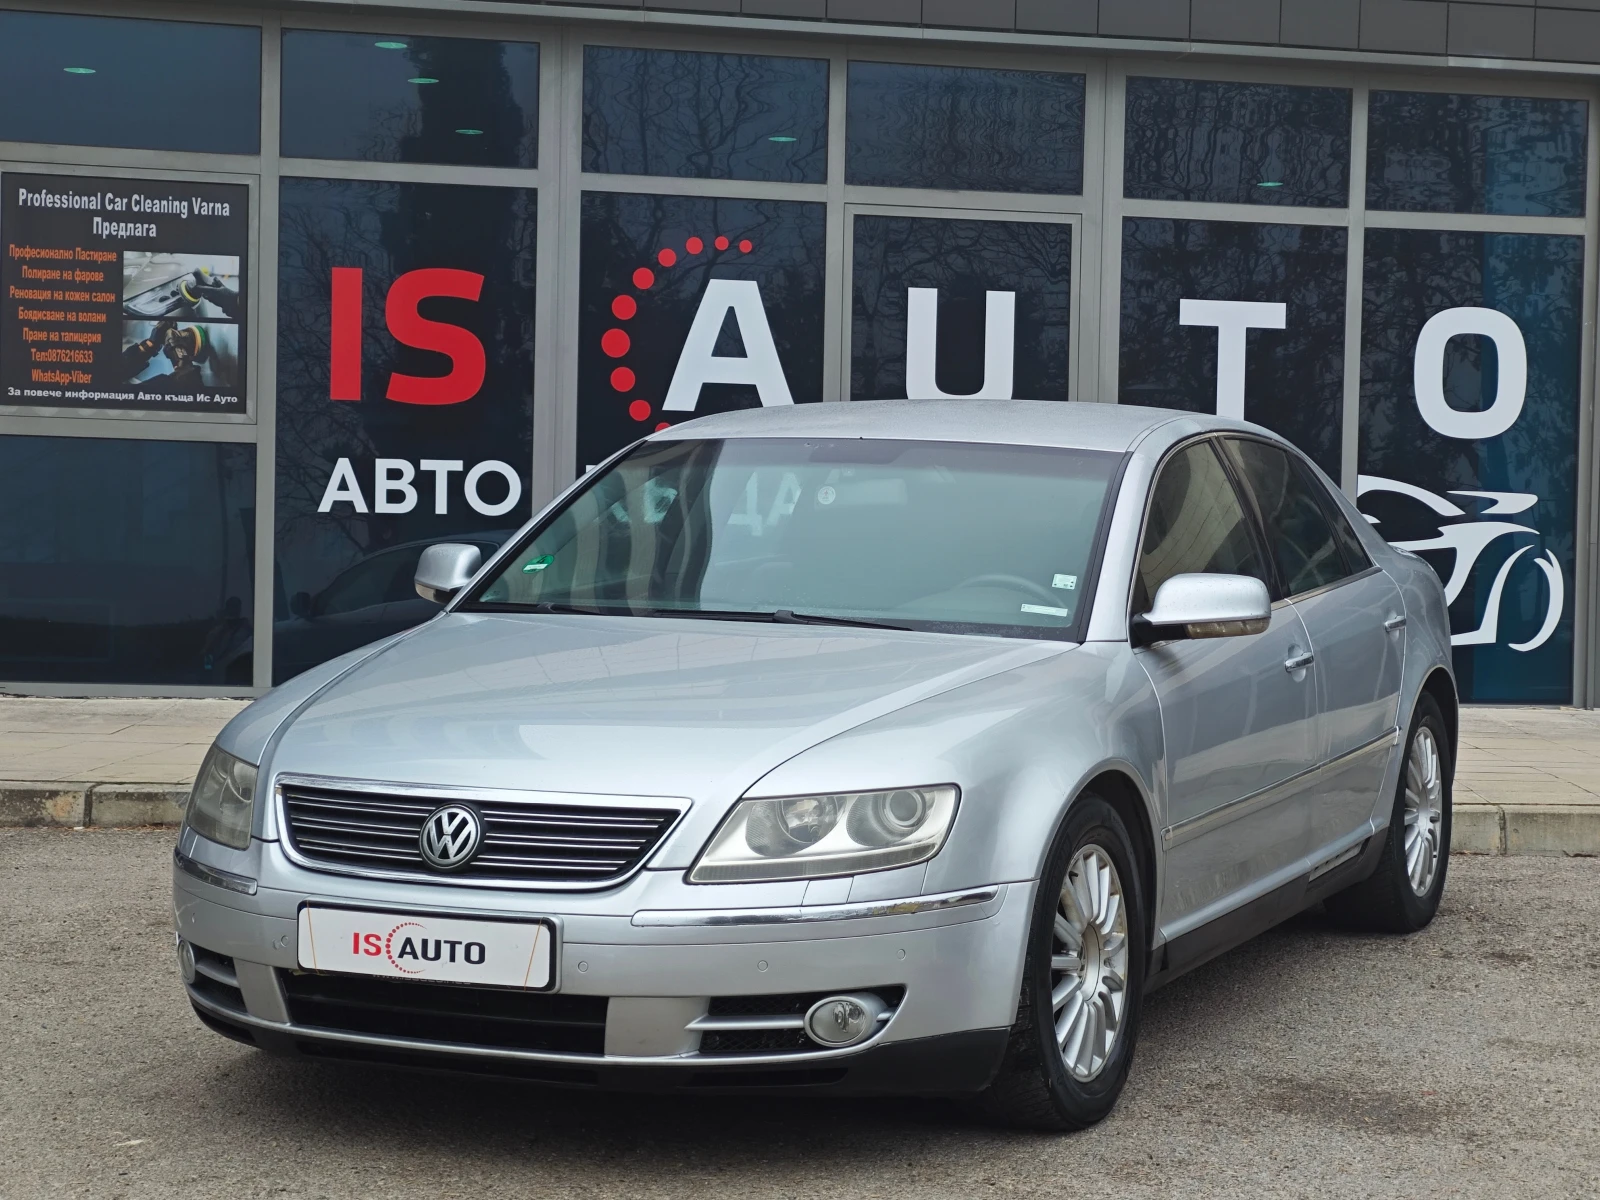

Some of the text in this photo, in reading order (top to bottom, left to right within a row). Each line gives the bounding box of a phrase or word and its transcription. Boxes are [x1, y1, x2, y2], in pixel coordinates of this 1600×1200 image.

[18, 187, 230, 219] Professional Car Cleaning Varna
[92, 216, 157, 240] Предлага
[9, 243, 117, 265] Професионално Пастиране
[22, 265, 104, 284] Полиране на фарове
[9, 285, 116, 303] Реновация на кожен салон
[18, 306, 107, 323] Боядисване на волани
[23, 327, 102, 346] Пране на тапицерия
[30, 348, 93, 364] Тел:0876216633
[330, 266, 1527, 440] IS AUTO
[31, 368, 92, 386] WhatsApp-Viber
[8, 386, 238, 405] За повече информация Авто къща Ис Ауто
[317, 457, 522, 517] АВТО
[352, 932, 486, 965] IS AUTO
